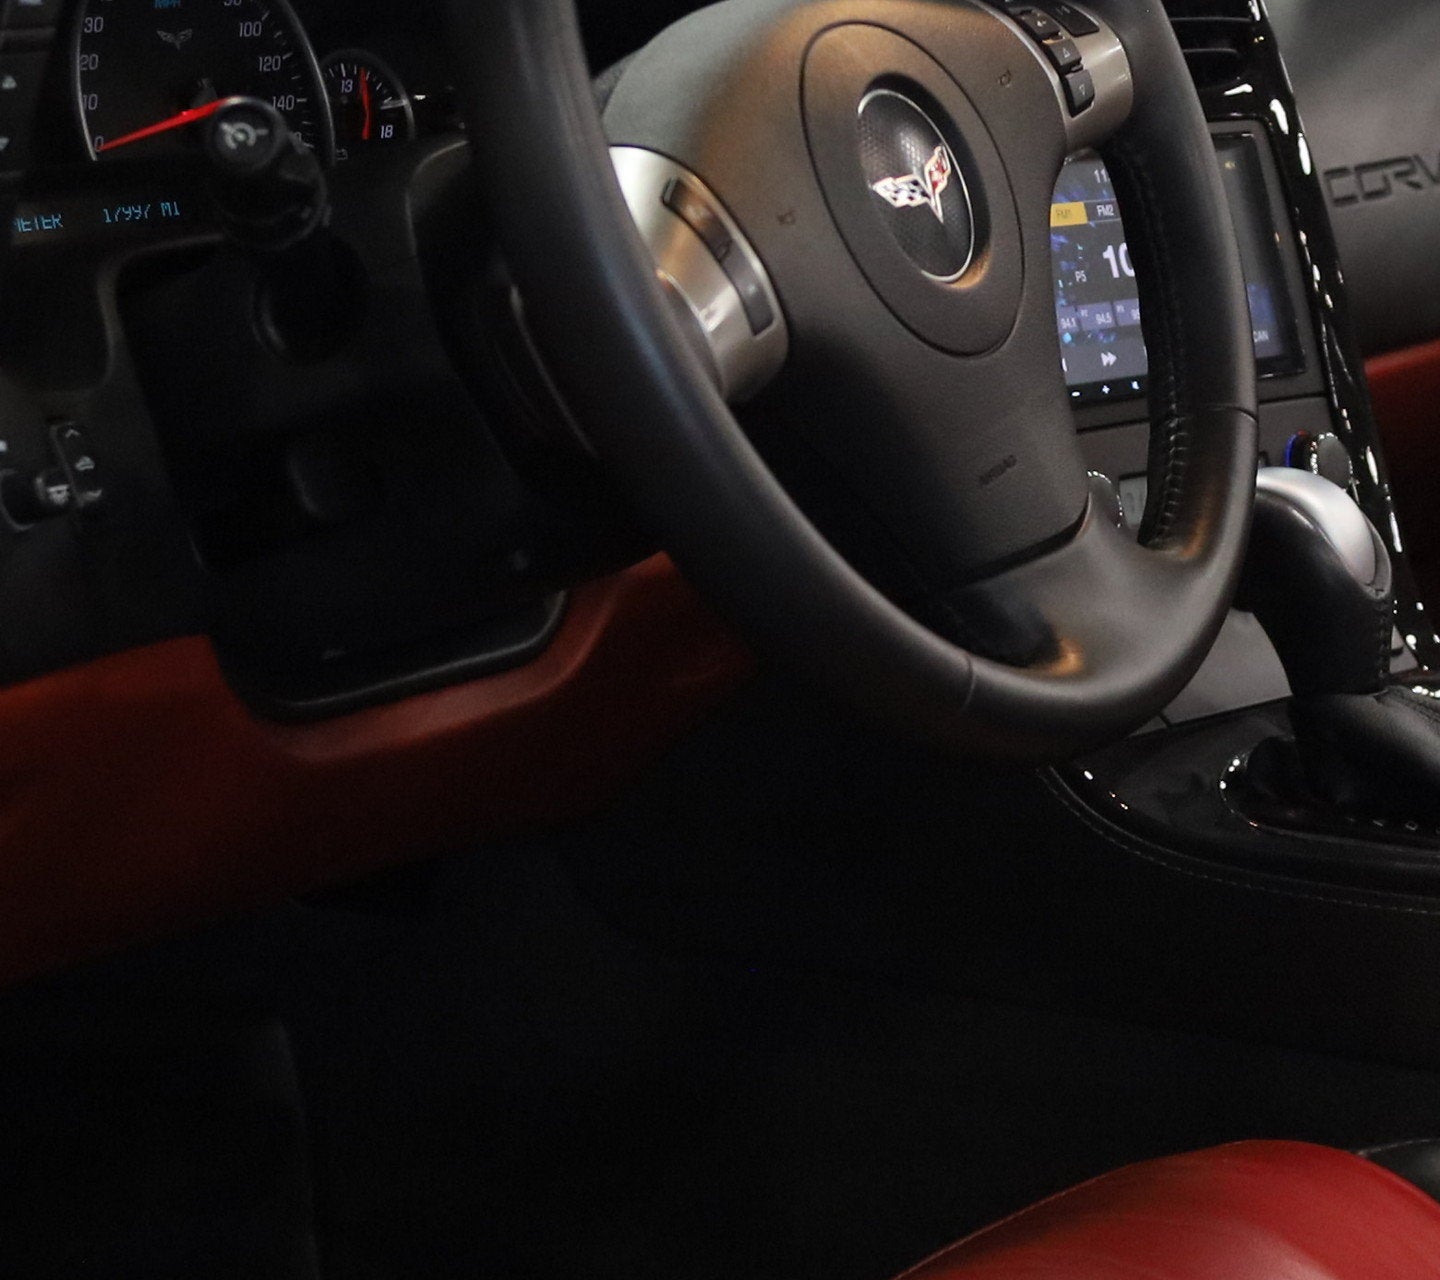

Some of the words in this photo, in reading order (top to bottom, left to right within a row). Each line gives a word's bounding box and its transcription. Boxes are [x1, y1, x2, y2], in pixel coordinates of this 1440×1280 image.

[83, 17, 104, 34] 30
[238, 21, 262, 38] 100
[78, 54, 100, 72] 20
[258, 55, 282, 72] 120
[341, 78, 354, 94] 13
[81, 93, 99, 111] 10
[271, 94, 295, 111] 140
[379, 124, 394, 140] 18
[1096, 203, 1114, 216] FM2
